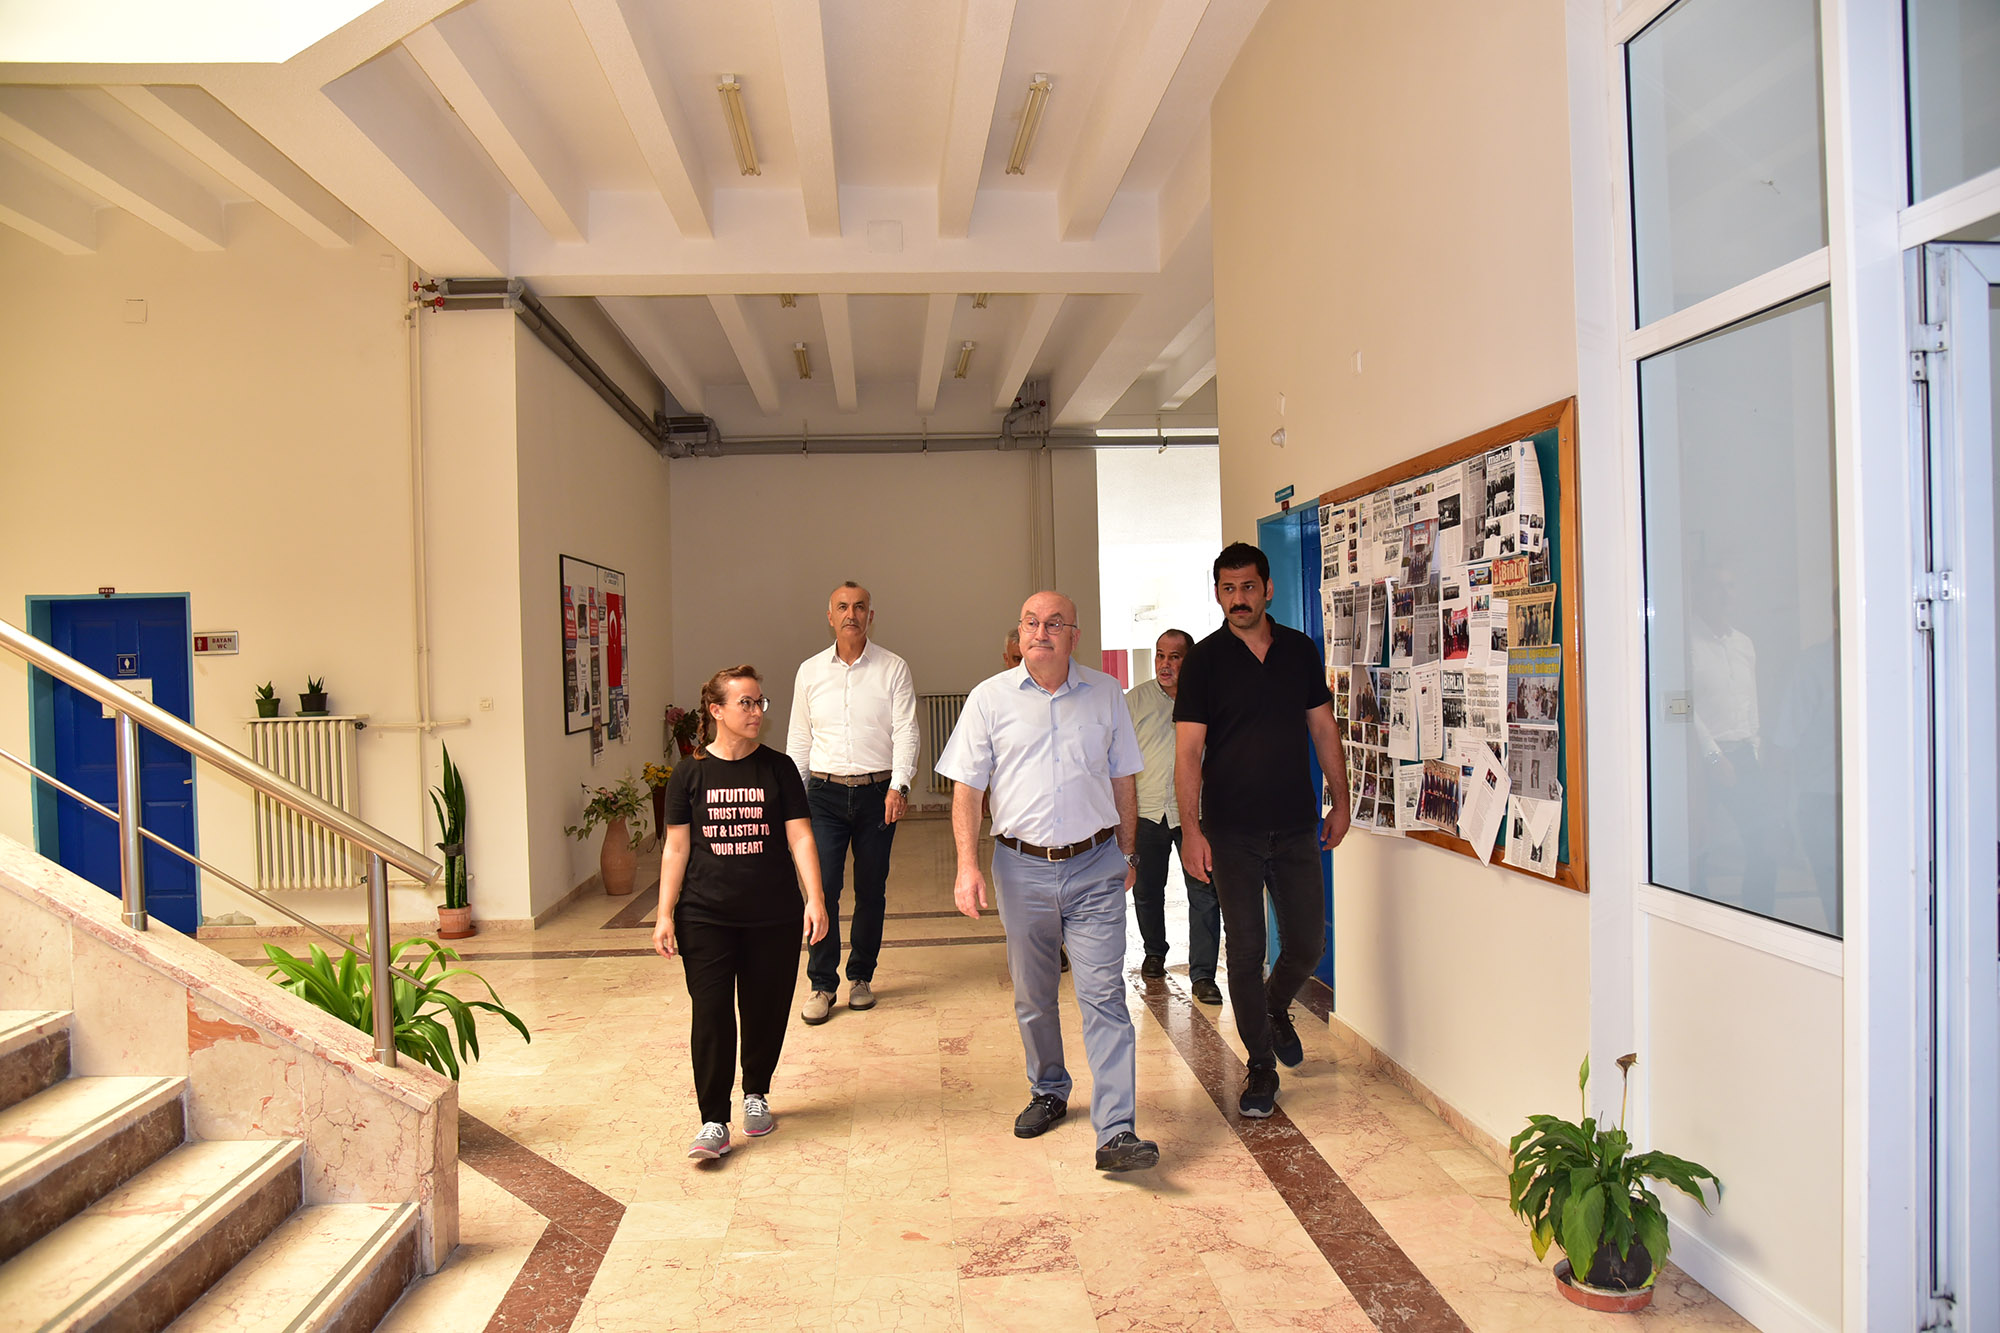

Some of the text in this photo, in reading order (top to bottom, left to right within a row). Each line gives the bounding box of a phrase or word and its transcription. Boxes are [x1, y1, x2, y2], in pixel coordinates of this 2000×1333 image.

[1488, 447, 1512, 465] markaj
[706, 788, 765, 804] INTUITION
[707, 807, 763, 820] TRUST YOUR
[702, 823, 770, 838] GUT & LISTEN TO
[710, 841, 763, 856] YOUR HEART
